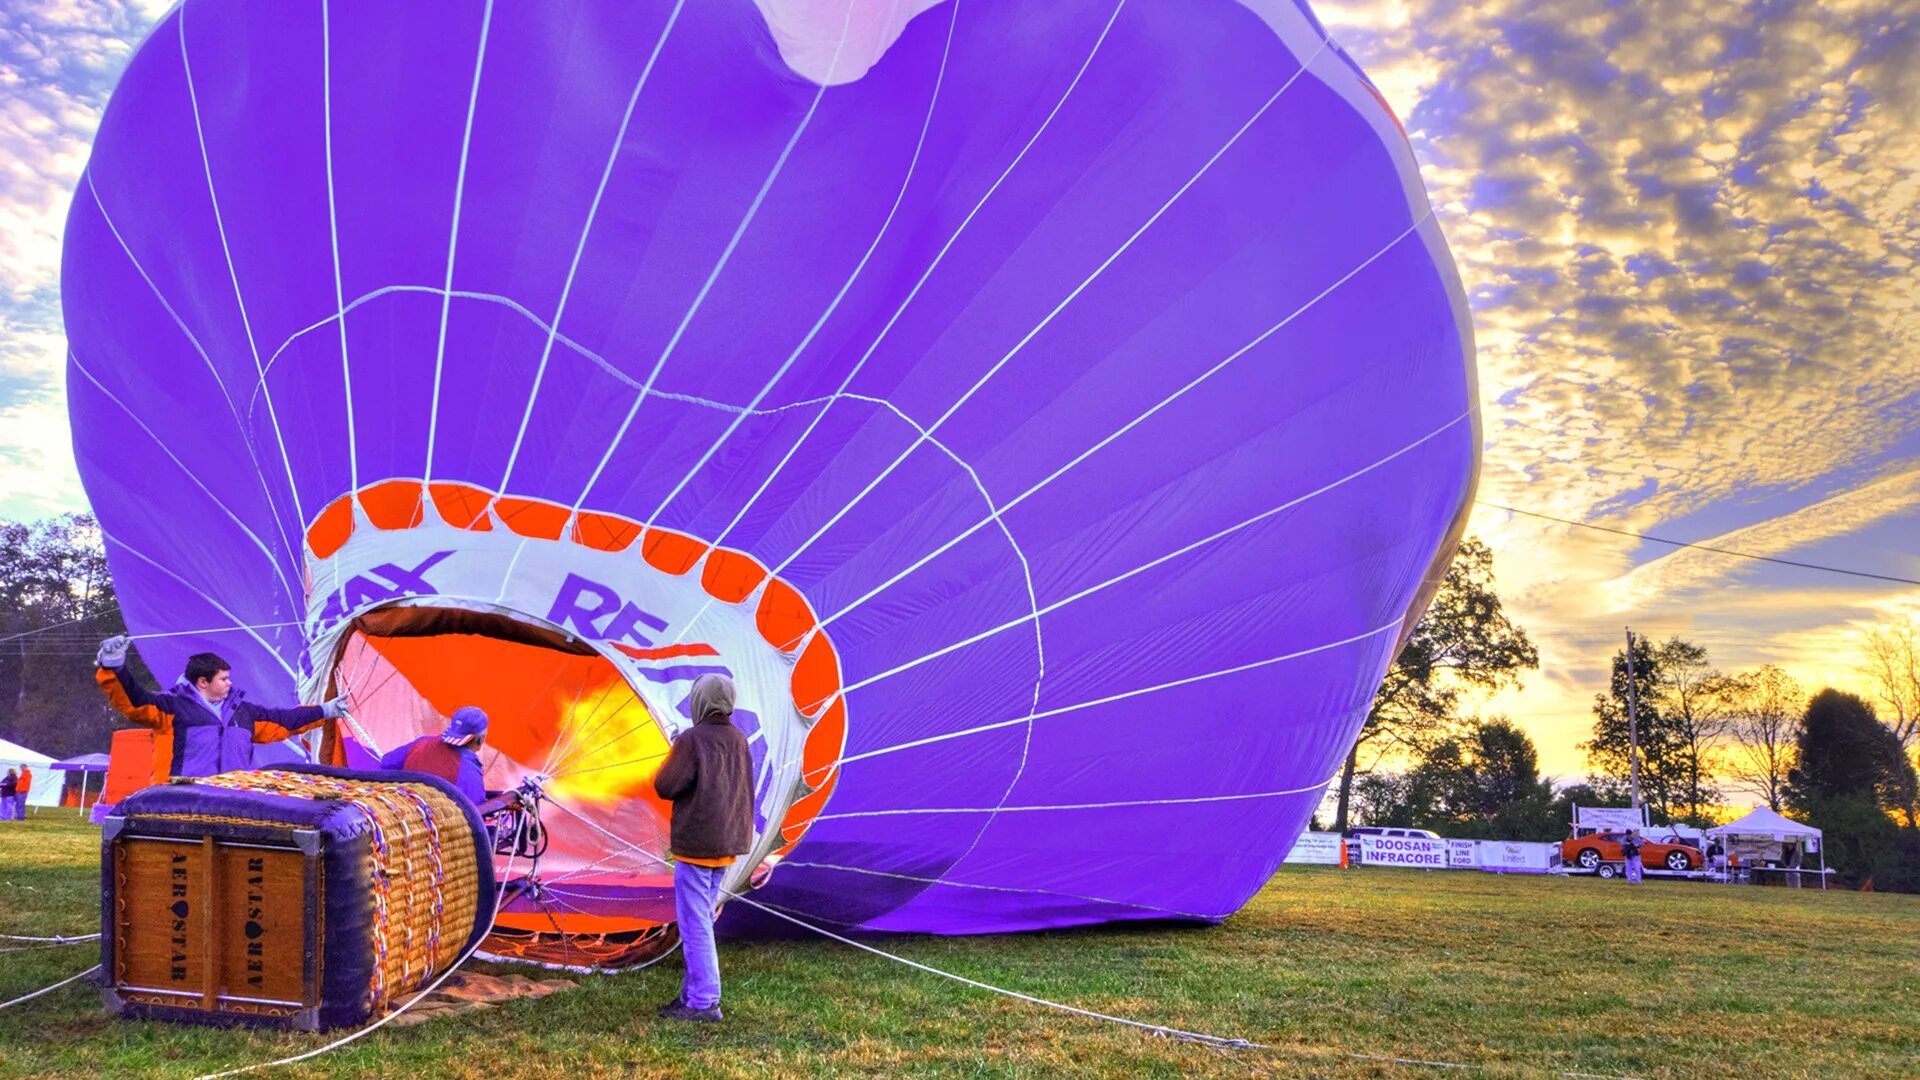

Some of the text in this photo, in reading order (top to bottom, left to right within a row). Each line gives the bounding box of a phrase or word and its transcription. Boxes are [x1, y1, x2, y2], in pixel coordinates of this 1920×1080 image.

[1375, 839, 1431, 852] DOOSAN
[1451, 841, 1472, 849] FINISH
[1366, 850, 1441, 864] INFRACORE
